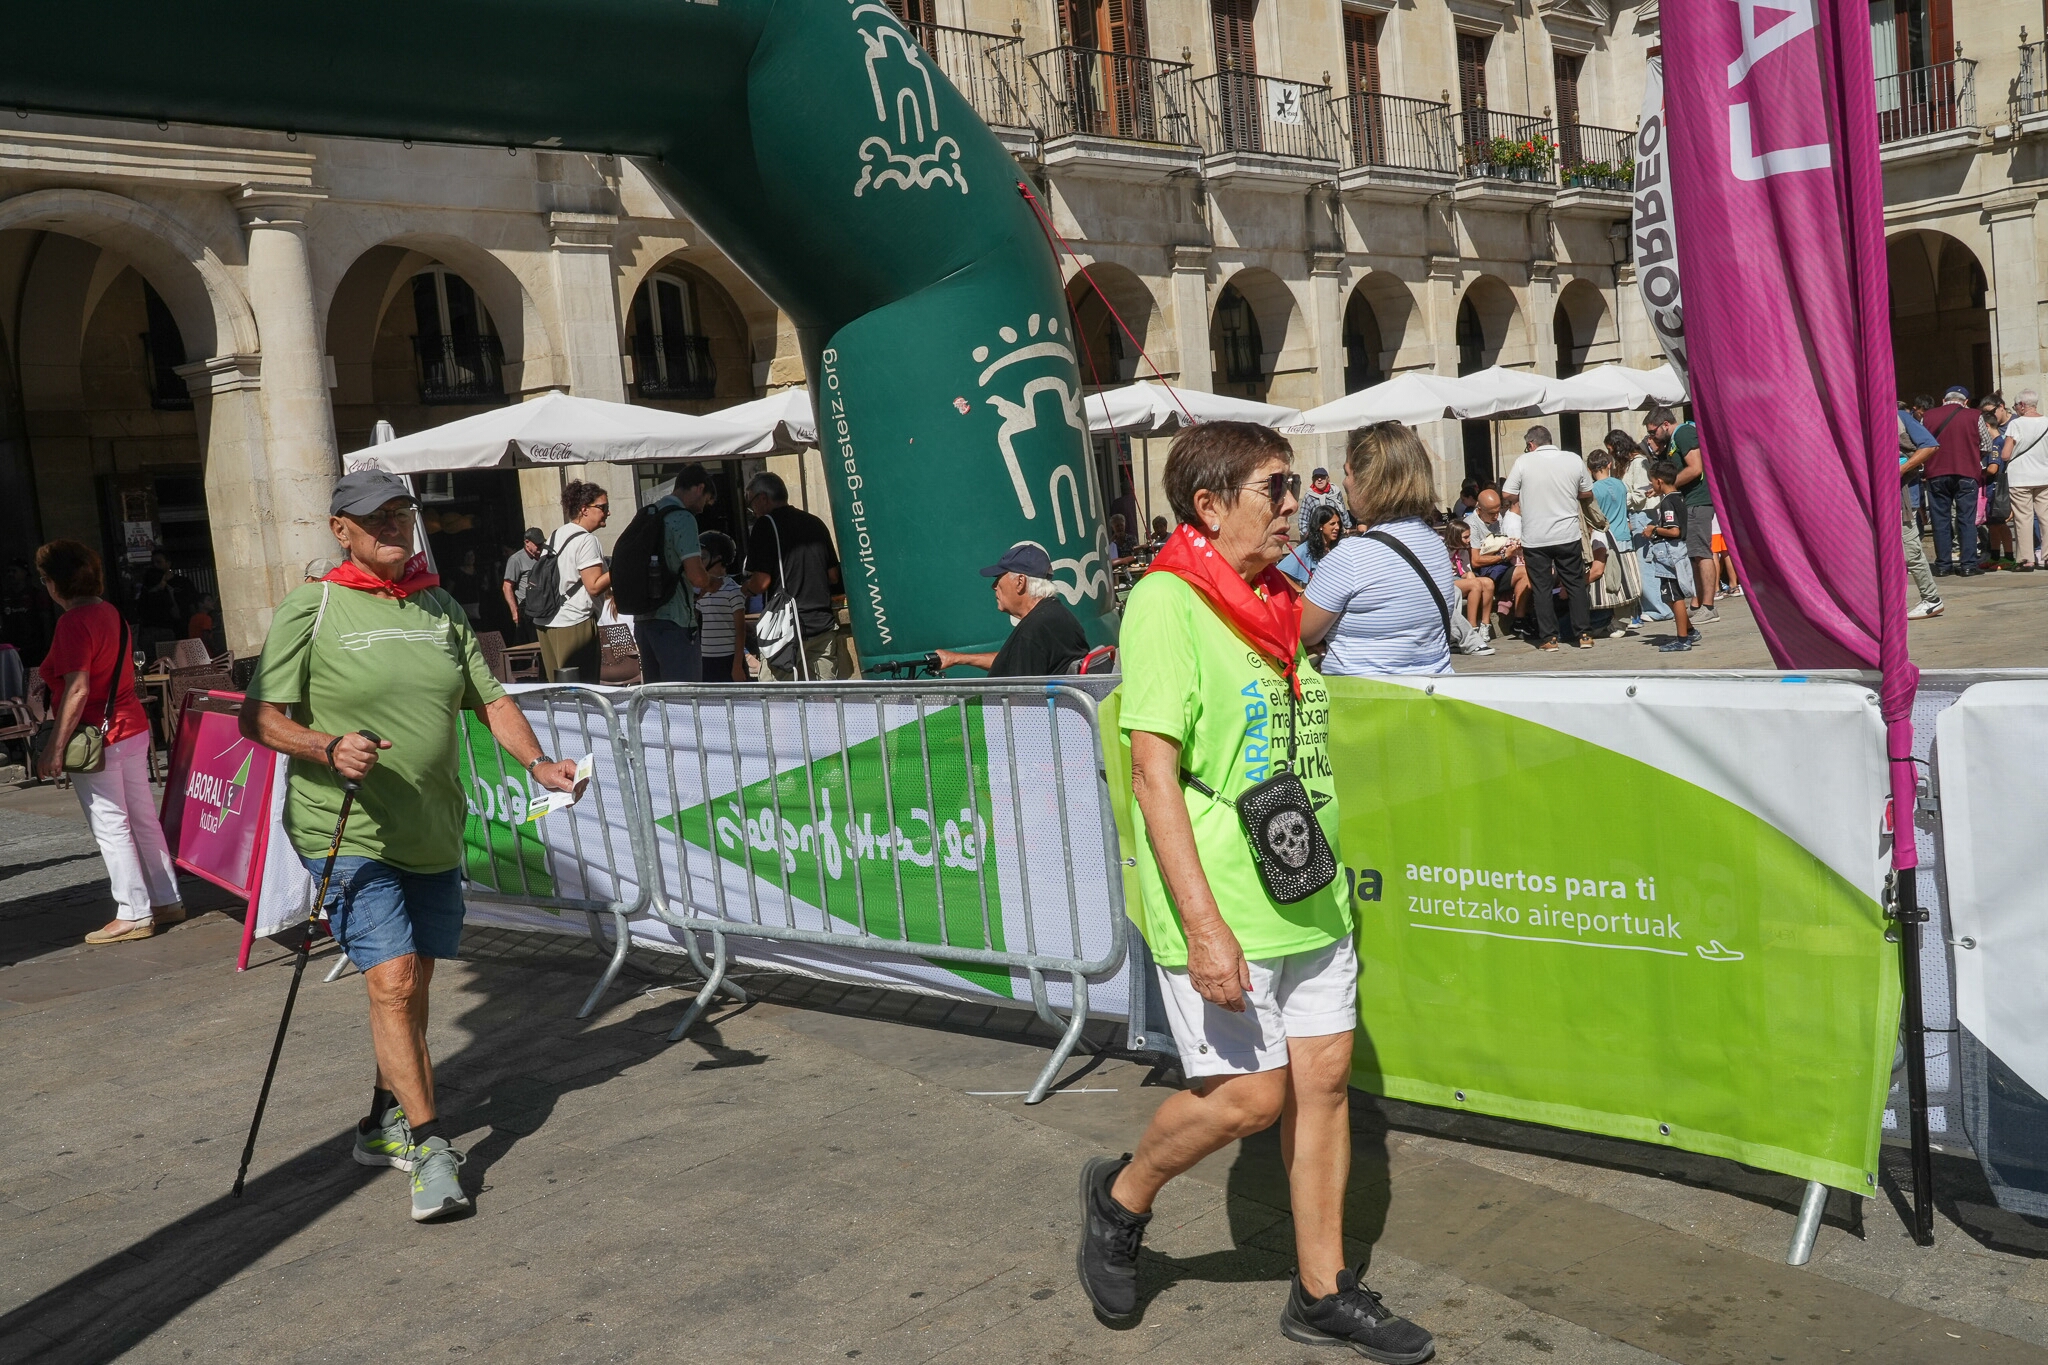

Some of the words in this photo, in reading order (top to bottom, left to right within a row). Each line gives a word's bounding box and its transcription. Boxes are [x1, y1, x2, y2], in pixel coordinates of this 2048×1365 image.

[822, 347, 893, 645] www.vitoria-gasteiz.org
[1270, 688, 1283, 706] el
[1240, 679, 1269, 784] ARABA
[1272, 708, 1329, 729] matxan
[199, 808, 219, 834] kutxa
[1406, 863, 1557, 893] aeropuertos
[1565, 876, 1626, 901] para
[1635, 876, 1656, 901] ti
[1408, 895, 1520, 924] zuretzako
[1528, 903, 1683, 939] aireportuak
